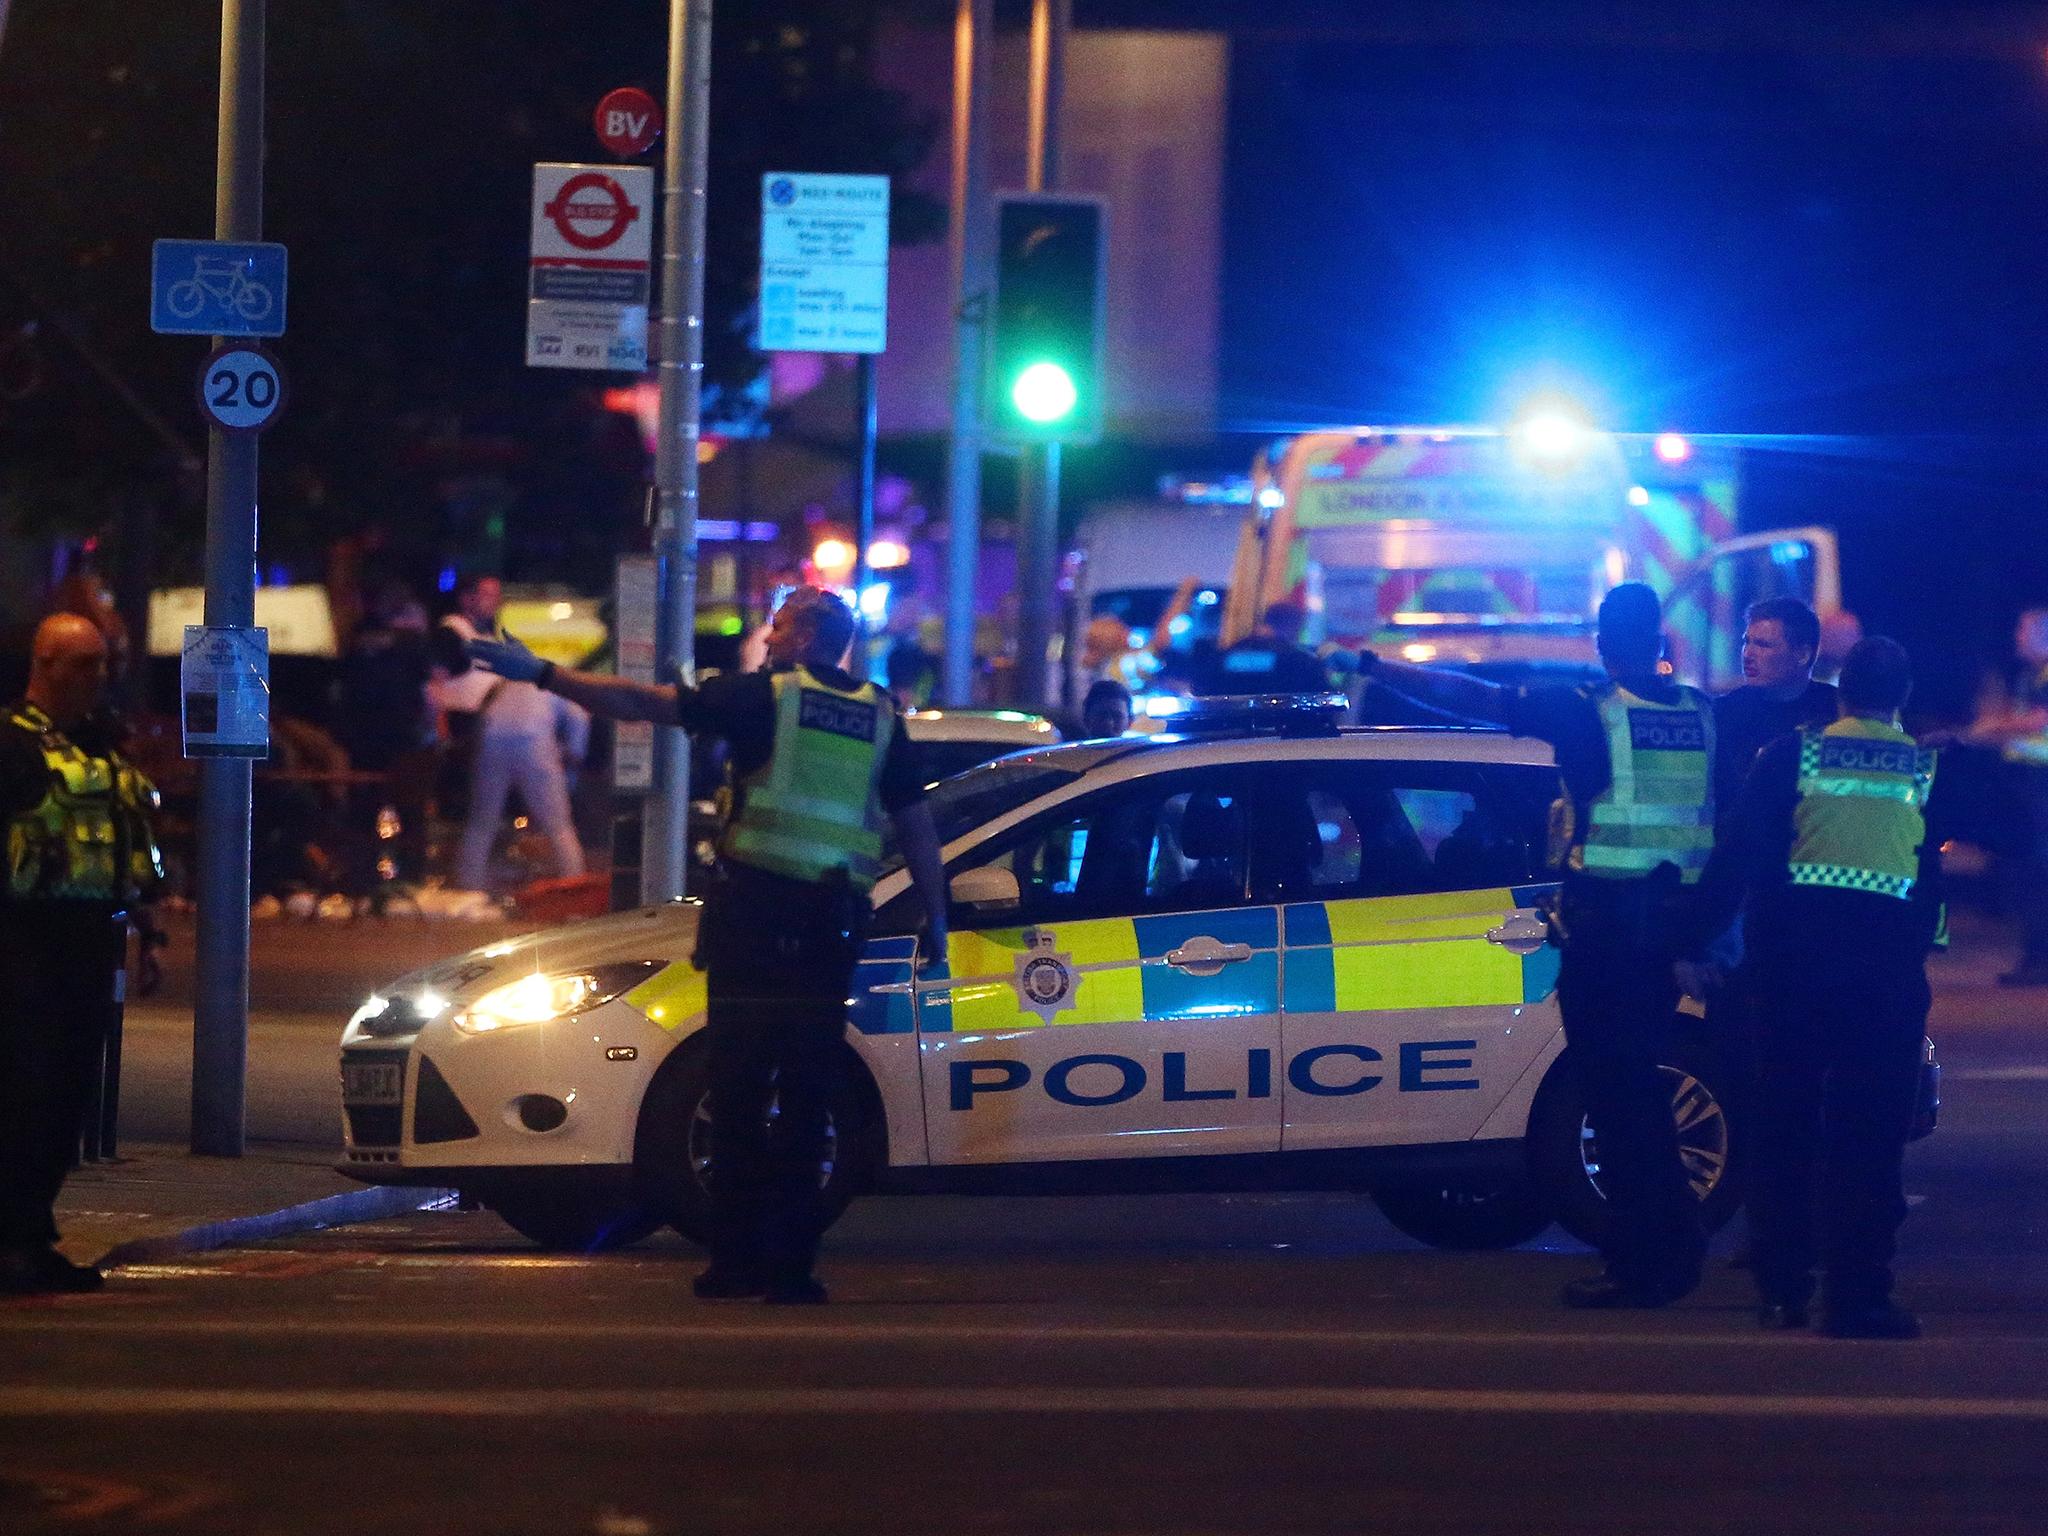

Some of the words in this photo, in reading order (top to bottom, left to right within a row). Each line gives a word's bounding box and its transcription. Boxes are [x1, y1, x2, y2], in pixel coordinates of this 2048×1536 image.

[607, 110, 650, 138] BV
[212, 369, 276, 409] 20
[1633, 725, 1702, 746] POLICE
[1824, 746, 1910, 772] POLICE
[948, 1038, 1481, 1112] POLICE
